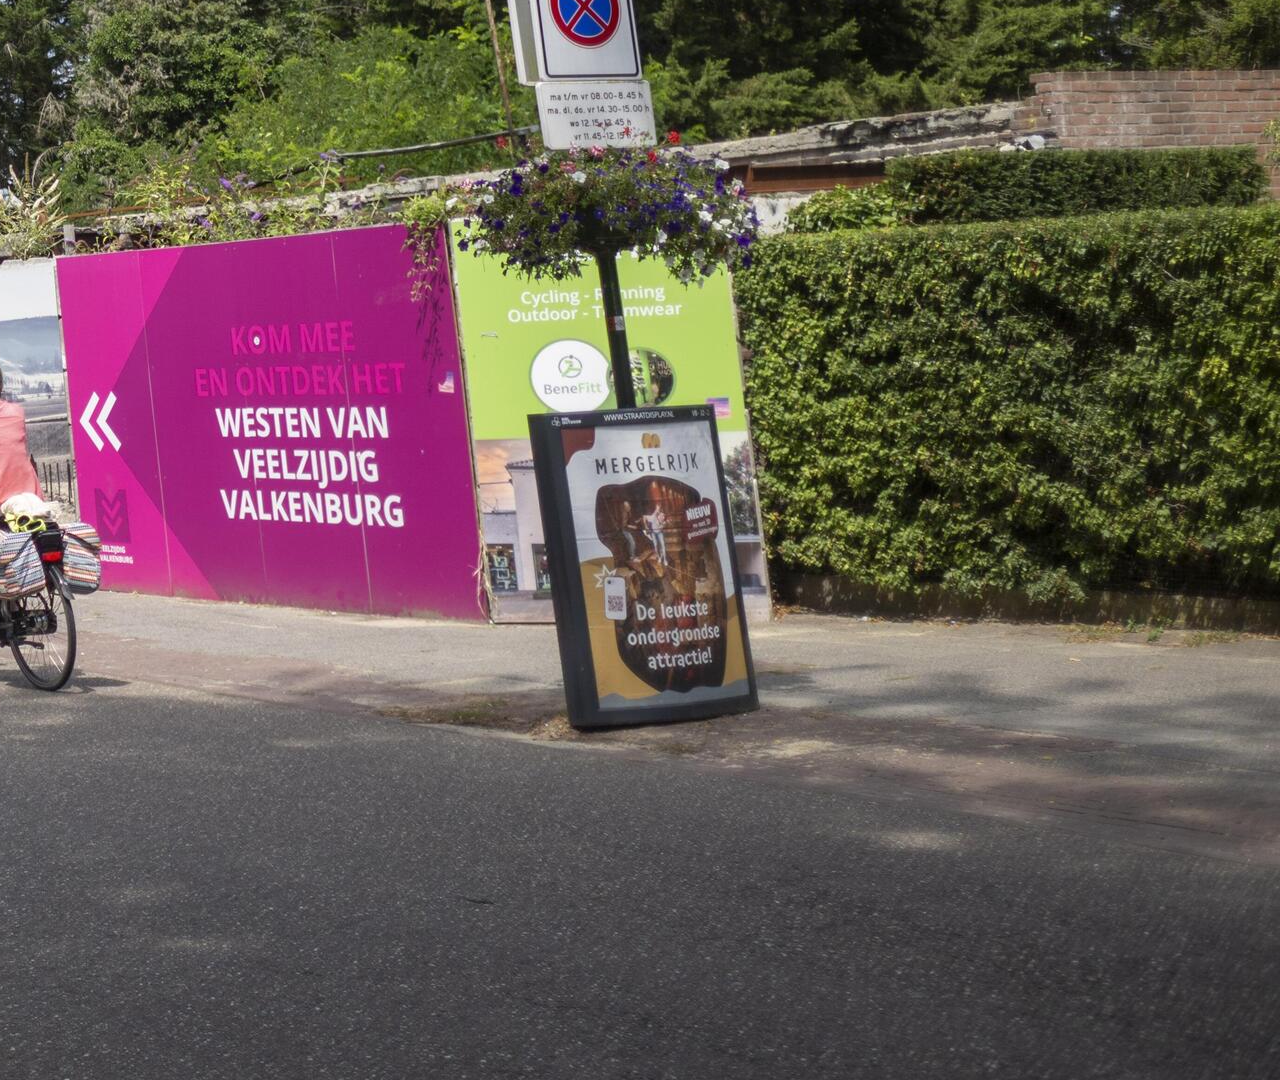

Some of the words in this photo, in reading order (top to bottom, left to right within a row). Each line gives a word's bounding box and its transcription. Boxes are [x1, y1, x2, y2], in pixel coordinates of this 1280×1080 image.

[563, 92, 578, 100] t/m
[644, 104, 650, 112] h
[521, 290, 580, 307] Cycling
[594, 286, 665, 302] Rnning
[508, 307, 578, 323] Outdoor
[592, 303, 683, 318] Tmwear
[231, 324, 291, 355] KOM
[300, 321, 355, 353] MEE
[195, 367, 228, 397] EN
[236, 365, 345, 397] ONTDEK
[352, 363, 405, 395] HET
[544, 382, 602, 395] BeneFitt
[215, 407, 321, 438] WESTEN
[326, 406, 389, 438] VAN
[603, 410, 675, 422] WWW.STRAATDISPLAY.NL
[233, 449, 379, 489] VEELZIJDIG
[595, 453, 699, 474] MERGELRIJK
[220, 489, 405, 528] VALKENBURG
[686, 504, 711, 521] NIEUW
[101, 544, 126, 555] EELZIJDIG
[636, 602, 656, 621] De
[660, 601, 708, 619] leukste
[627, 624, 720, 647] ondergrondse
[648, 646, 713, 670] attractie!
